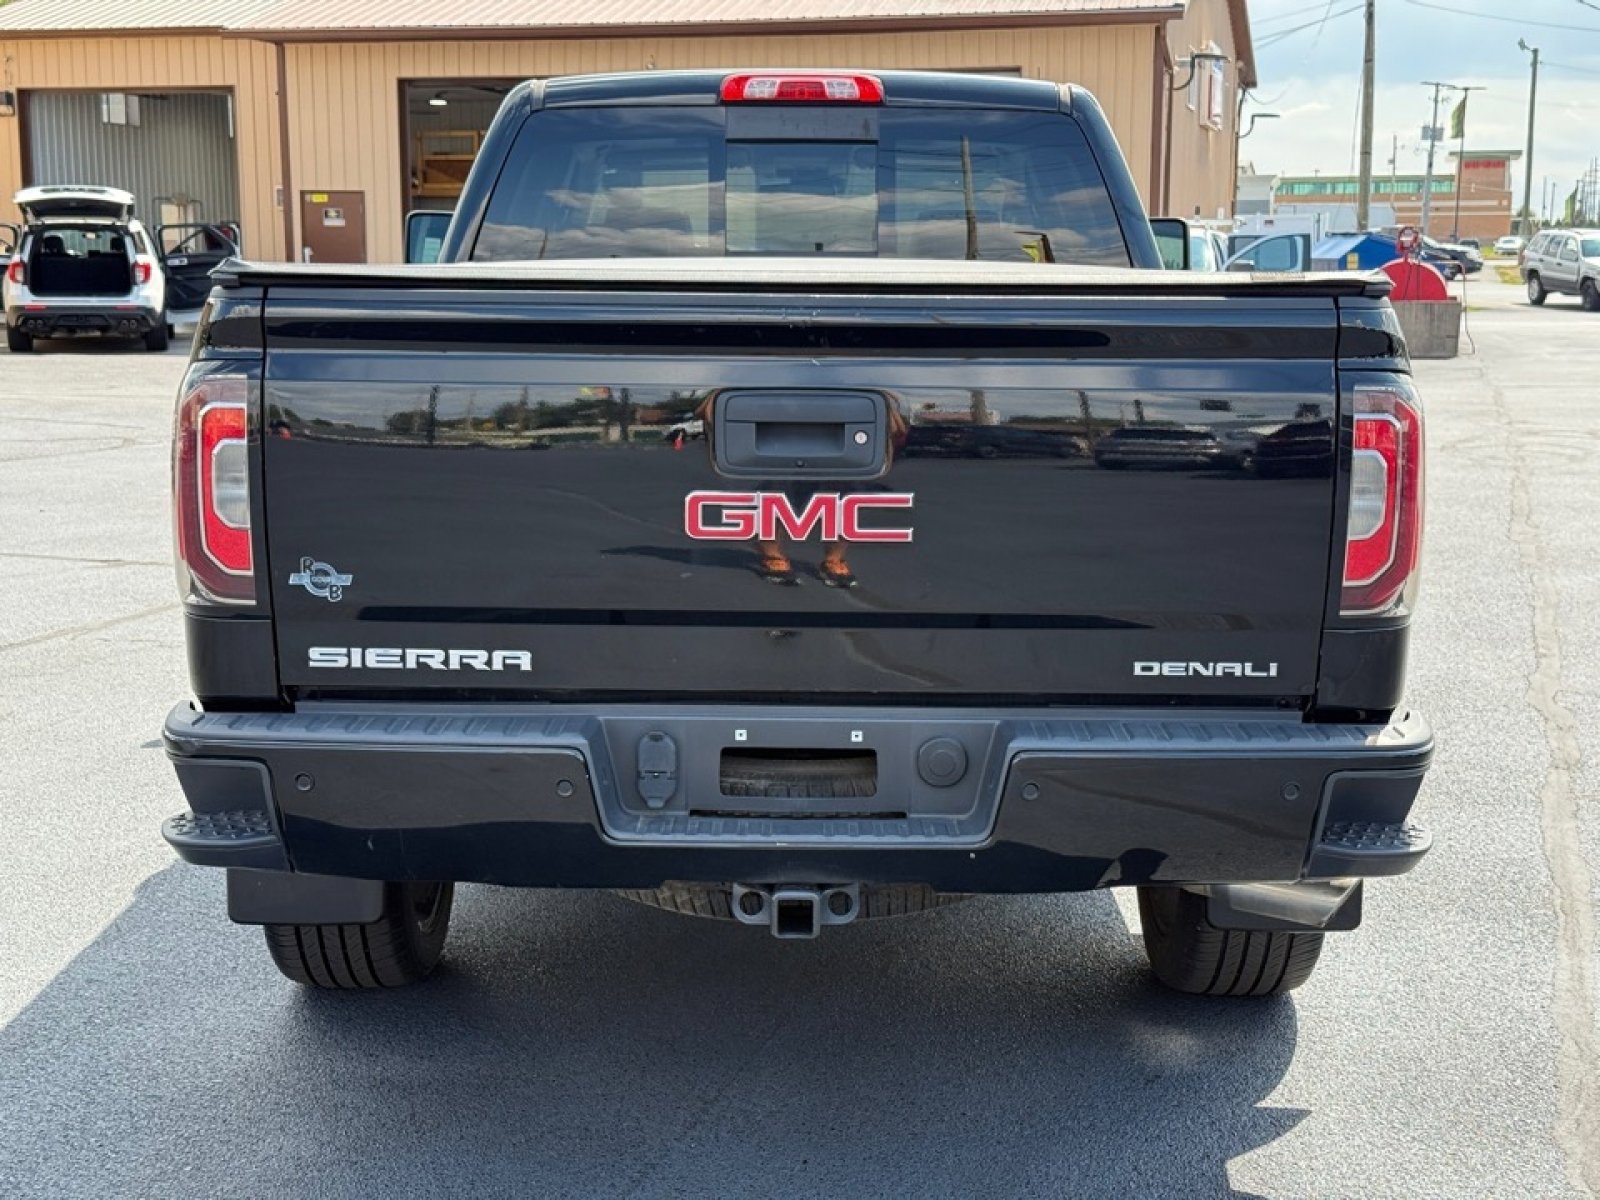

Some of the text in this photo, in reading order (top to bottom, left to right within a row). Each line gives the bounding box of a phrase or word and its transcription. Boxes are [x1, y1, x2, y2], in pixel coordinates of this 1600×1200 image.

[685, 490, 914, 542] GMC
[328, 585, 342, 602] B
[308, 647, 532, 670] SIERRA
[1133, 661, 1278, 677] DENALI
